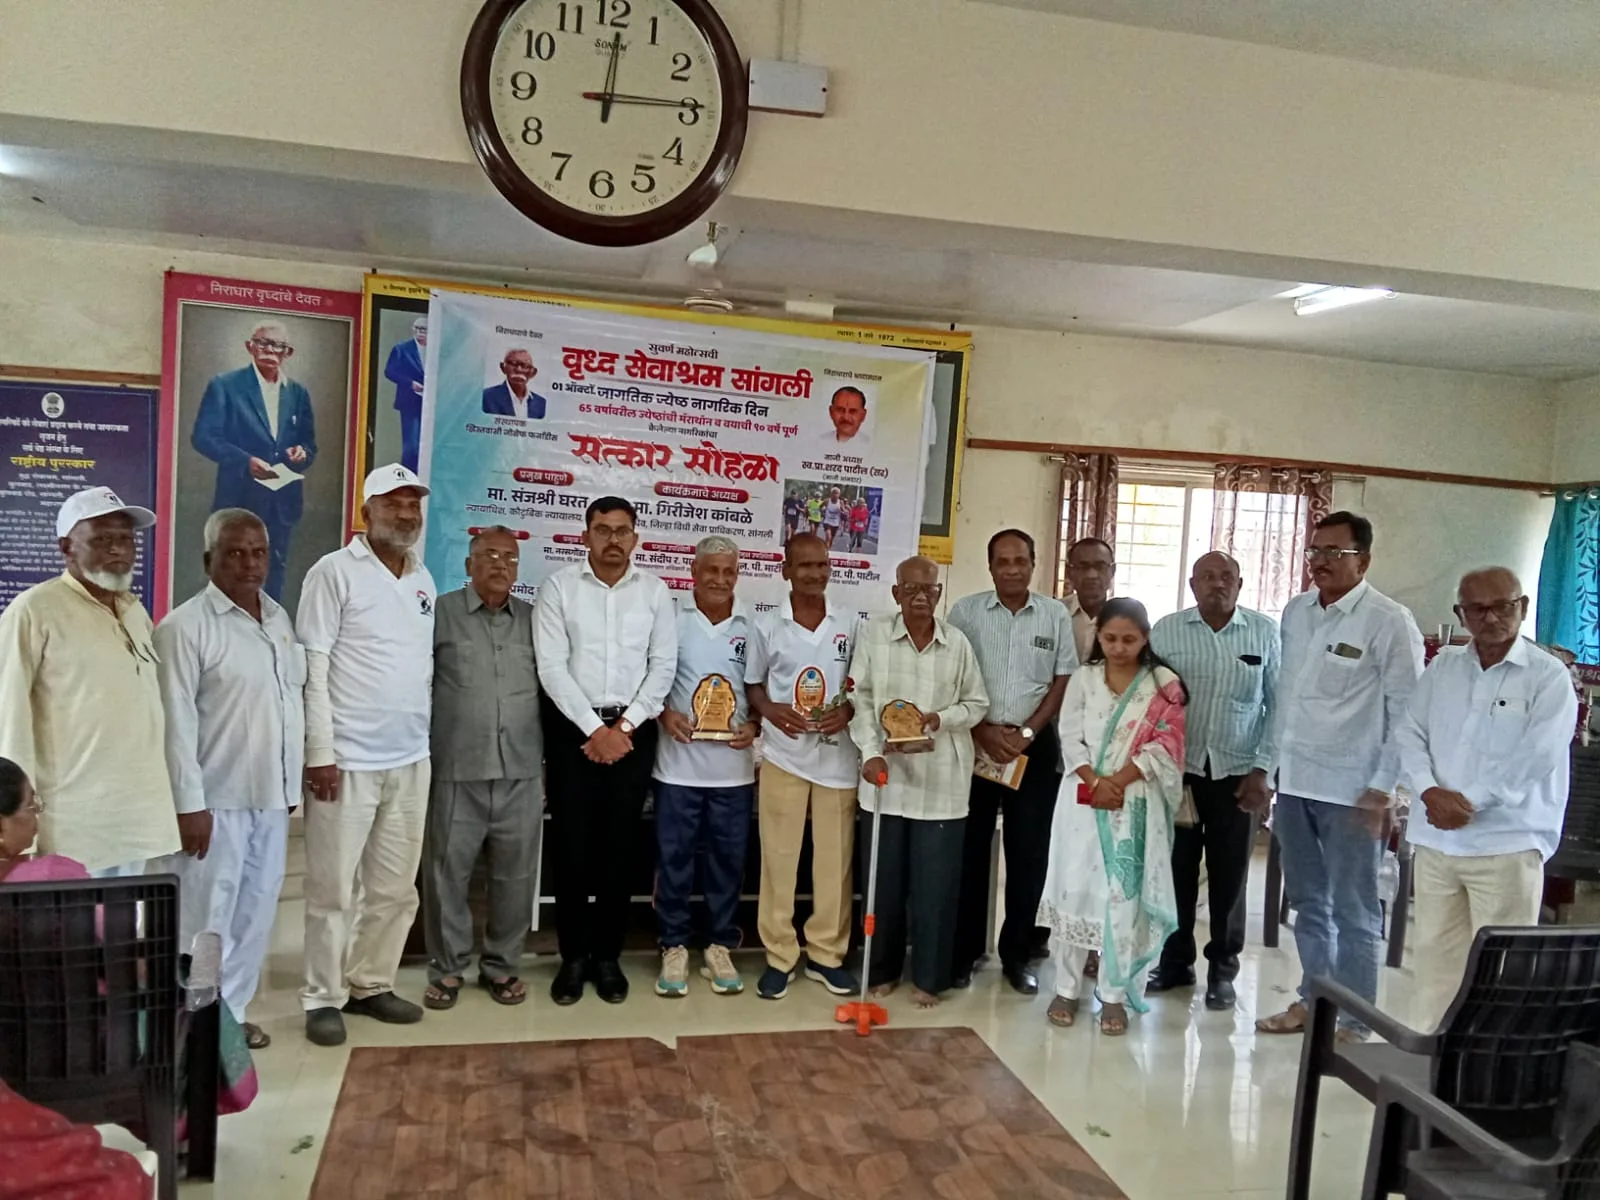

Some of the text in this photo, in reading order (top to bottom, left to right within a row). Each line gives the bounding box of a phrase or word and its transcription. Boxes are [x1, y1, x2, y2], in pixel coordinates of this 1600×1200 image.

[556, 2, 584, 35] 11
[596, 0, 631, 28] 12
[523, 29, 555, 61] 10
[648, 16, 659, 46] 1
[671, 53, 691, 82] 2
[510, 70, 537, 101] 9
[678, 97, 699, 126] 3
[521, 116, 543, 146] 8
[550, 151, 573, 181] 7
[662, 136, 683, 166] 4
[589, 170, 615, 199] 6
[631, 163, 656, 194] 5
[624, 349, 725, 388] सेवाश्रम
[731, 365, 814, 399] सांगली
[552, 382, 563, 392] 01
[597, 386, 655, 404] जागतिक
[656, 391, 690, 409] ज्येष्ठ
[691, 397, 744, 414] नागरिक
[745, 401, 769, 418] दिन
[578, 403, 592, 413] 65
[567, 431, 780, 484] सत्कार सोहळा
[487, 487, 590, 509] मा. संजश्री घरत
[656, 501, 709, 521] गिरीजेश
[711, 507, 754, 525] कांबळे
[649, 552, 673, 564] संदीप
